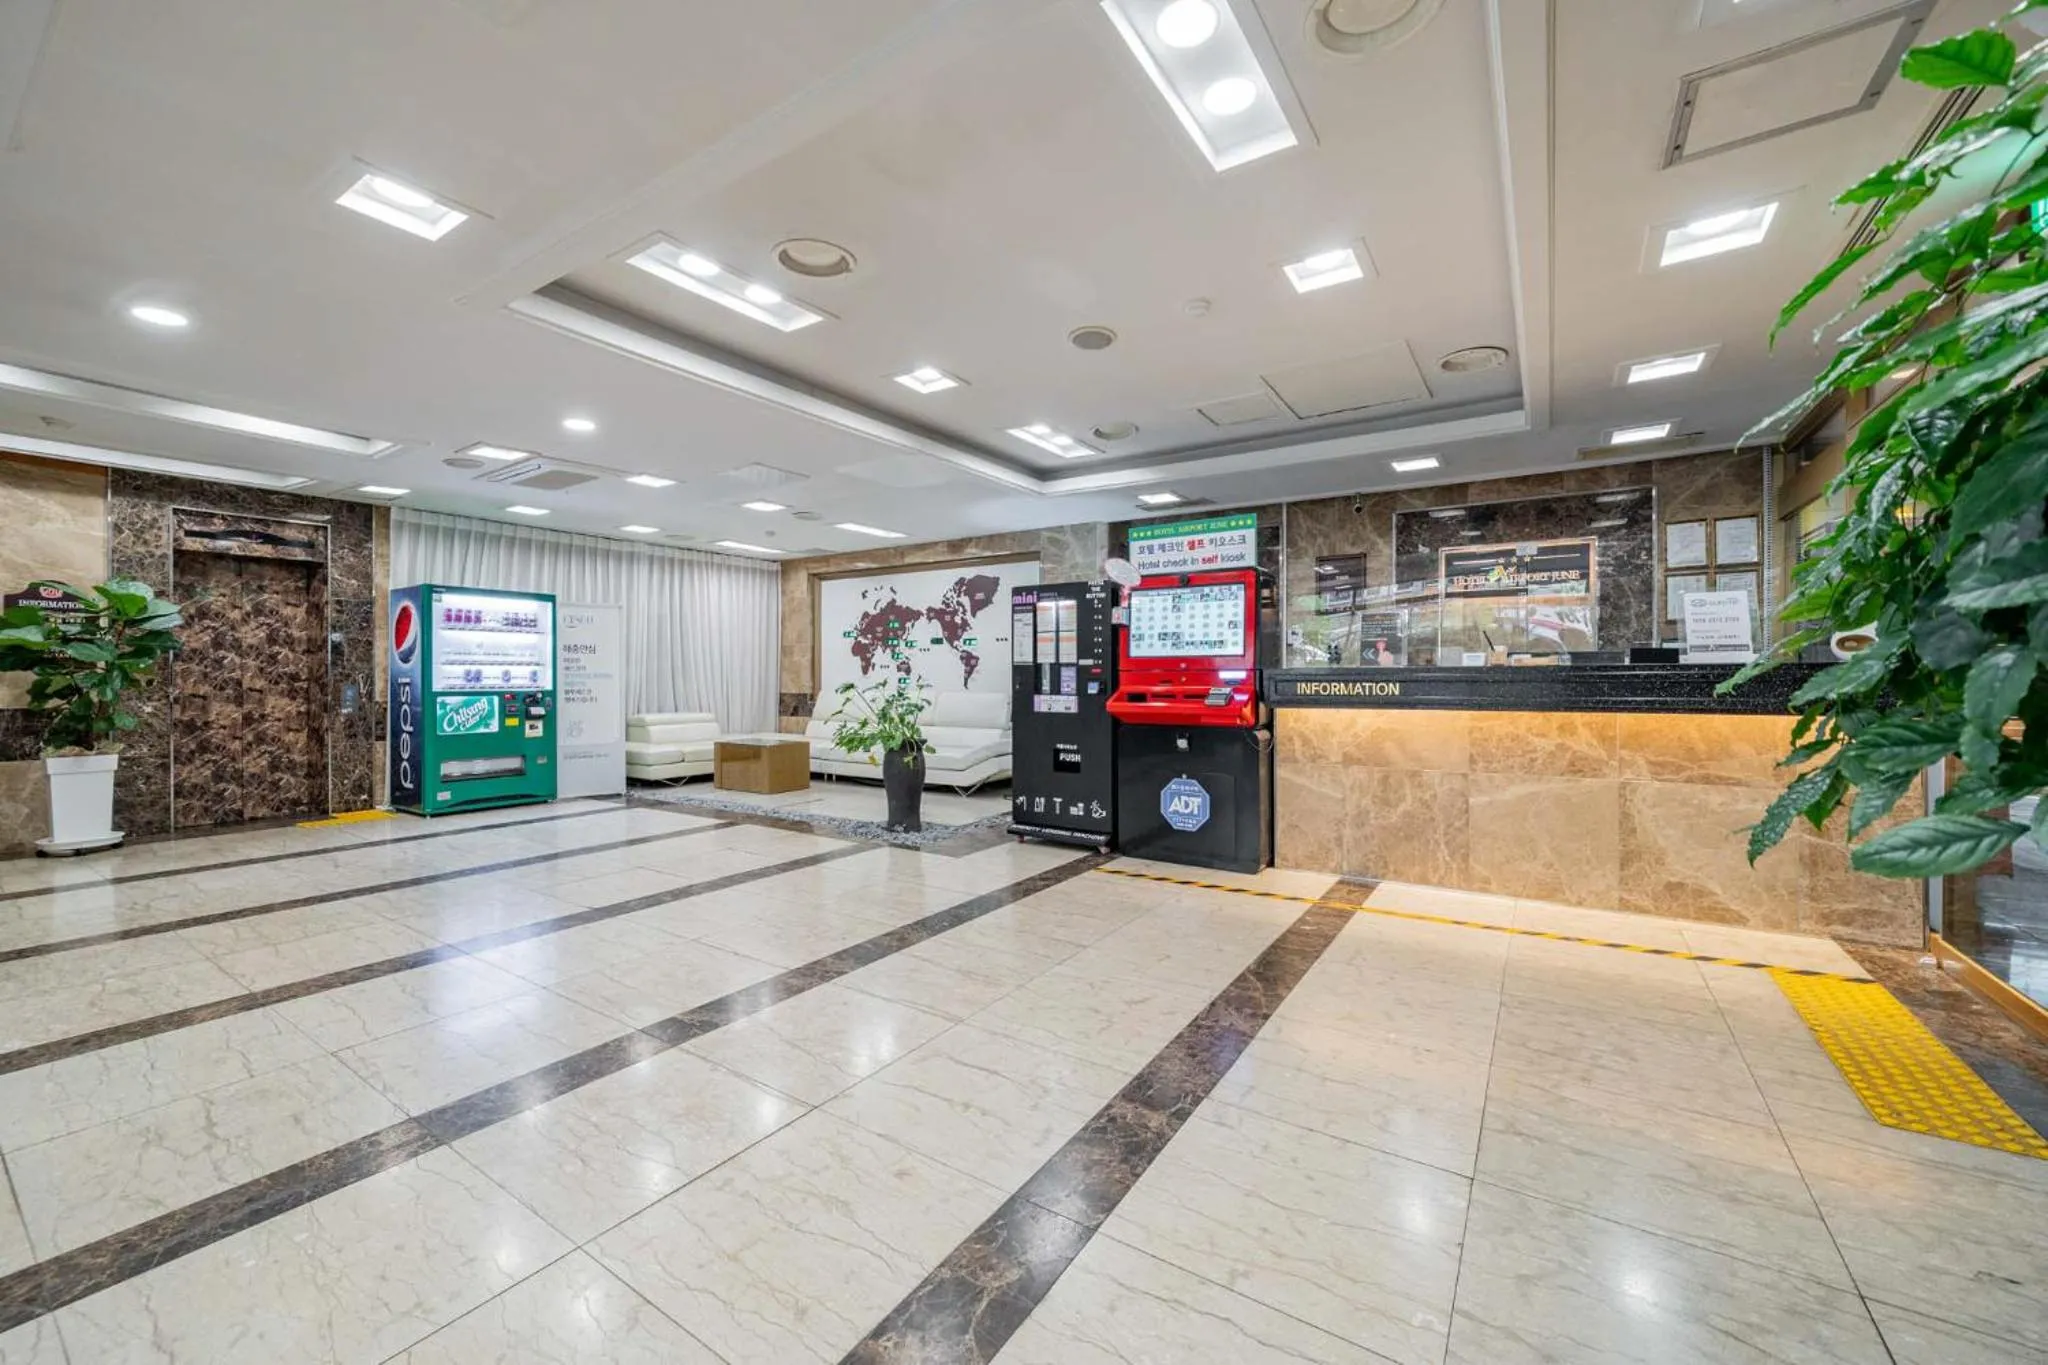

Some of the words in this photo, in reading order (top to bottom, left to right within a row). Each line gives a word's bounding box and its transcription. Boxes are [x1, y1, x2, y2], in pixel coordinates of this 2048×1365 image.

[1137, 544, 1155, 554] 호텔
[1208, 534, 1246, 547] 키오스크
[1138, 560, 1160, 570] Hotel
[1162, 557, 1188, 568] check
[1201, 554, 1218, 564] self
[1220, 551, 1246, 563] kiosk
[1453, 575, 1487, 585] HOTEL
[1551, 569, 1581, 582] JUNE
[1013, 591, 1038, 604] mini
[1296, 682, 1400, 696] INFORMATION
[398, 677, 414, 789] pepsi
[1059, 752, 1081, 763] PUSH
[1169, 795, 1202, 814] ADT
